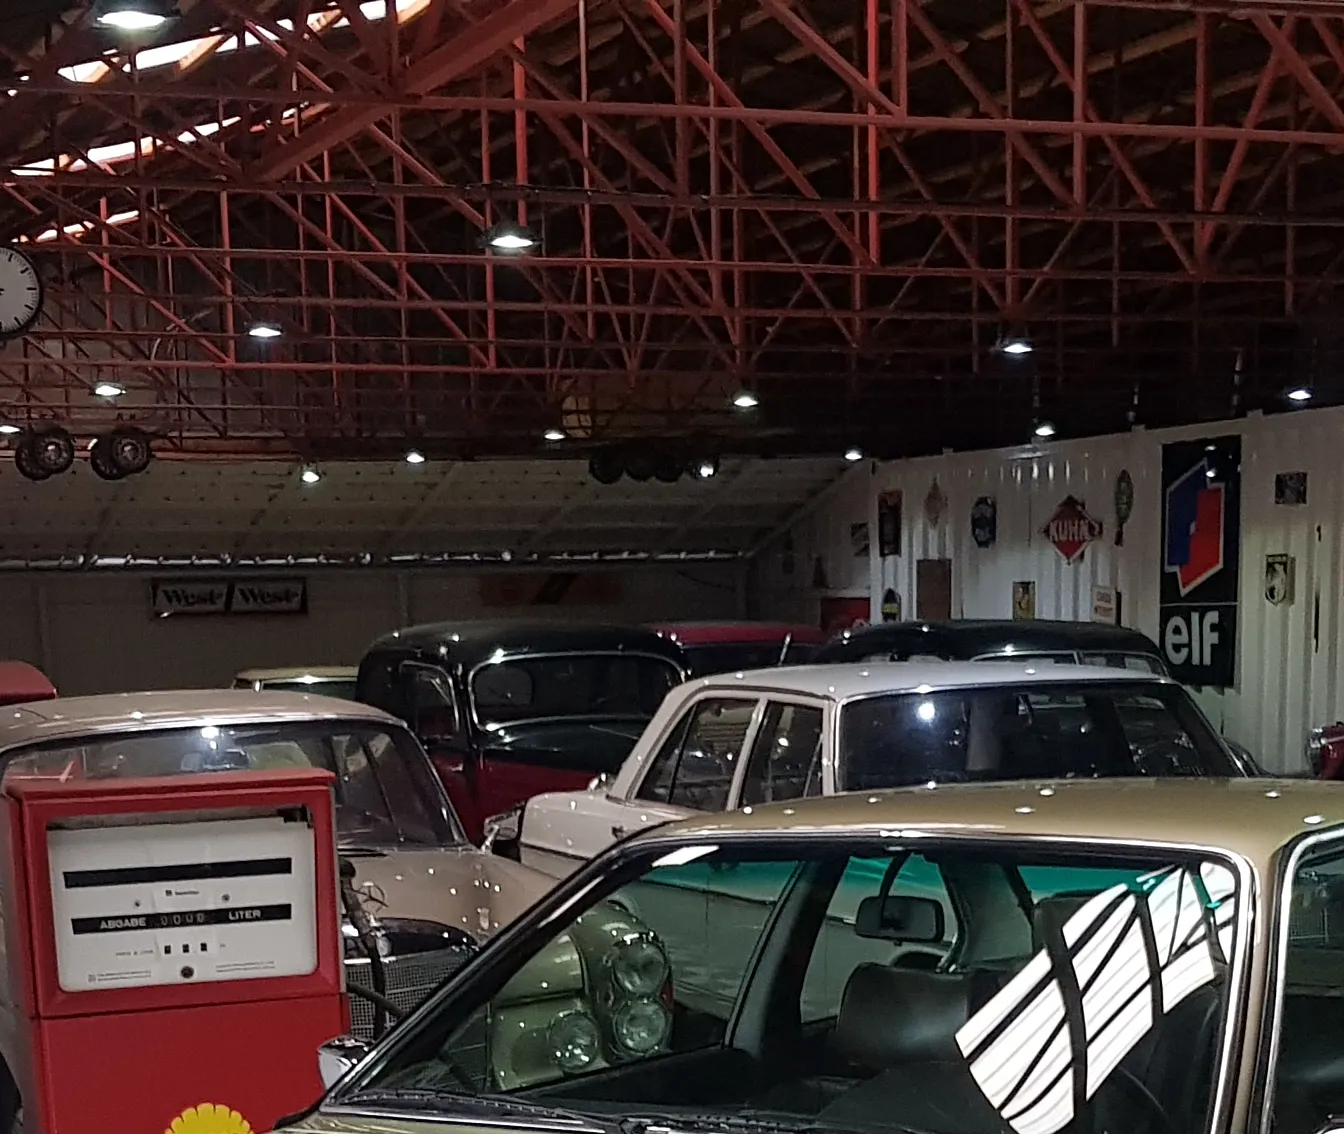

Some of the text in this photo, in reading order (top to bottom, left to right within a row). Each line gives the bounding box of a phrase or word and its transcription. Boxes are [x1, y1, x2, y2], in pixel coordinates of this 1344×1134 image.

[1050, 519, 1091, 542] KUHN
[1165, 609, 1220, 668] elf
[100, 917, 147, 930] ABGABE
[228, 909, 262, 921] LITER
